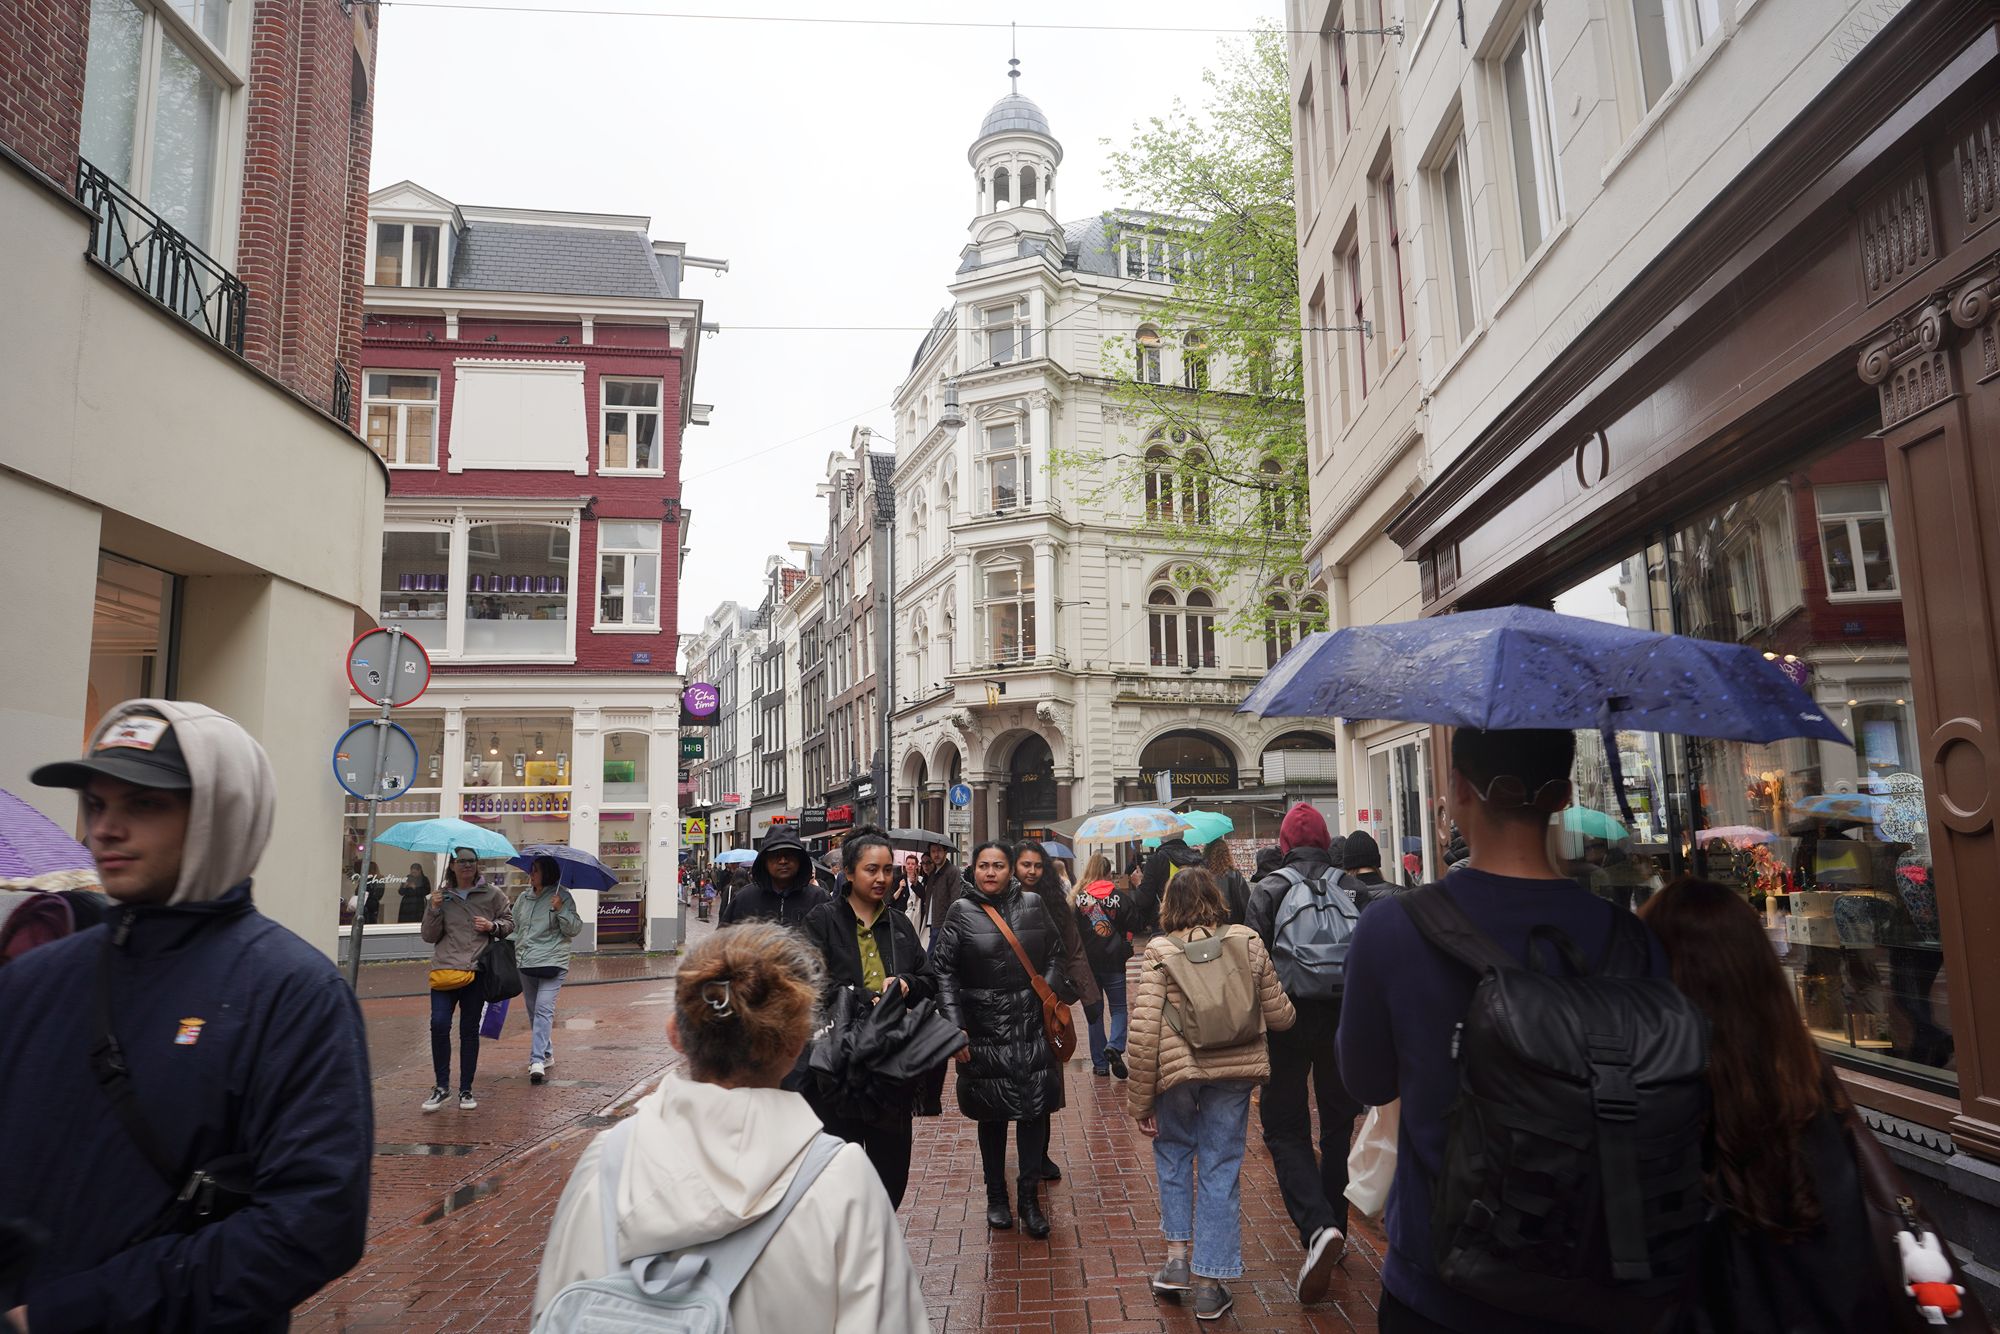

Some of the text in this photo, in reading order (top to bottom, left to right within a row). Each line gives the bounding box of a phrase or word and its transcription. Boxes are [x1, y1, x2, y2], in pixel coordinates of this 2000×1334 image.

[695, 691, 715, 700] Cha
[694, 701, 716, 710] time
[1142, 773, 1230, 785] WAERSTONES
